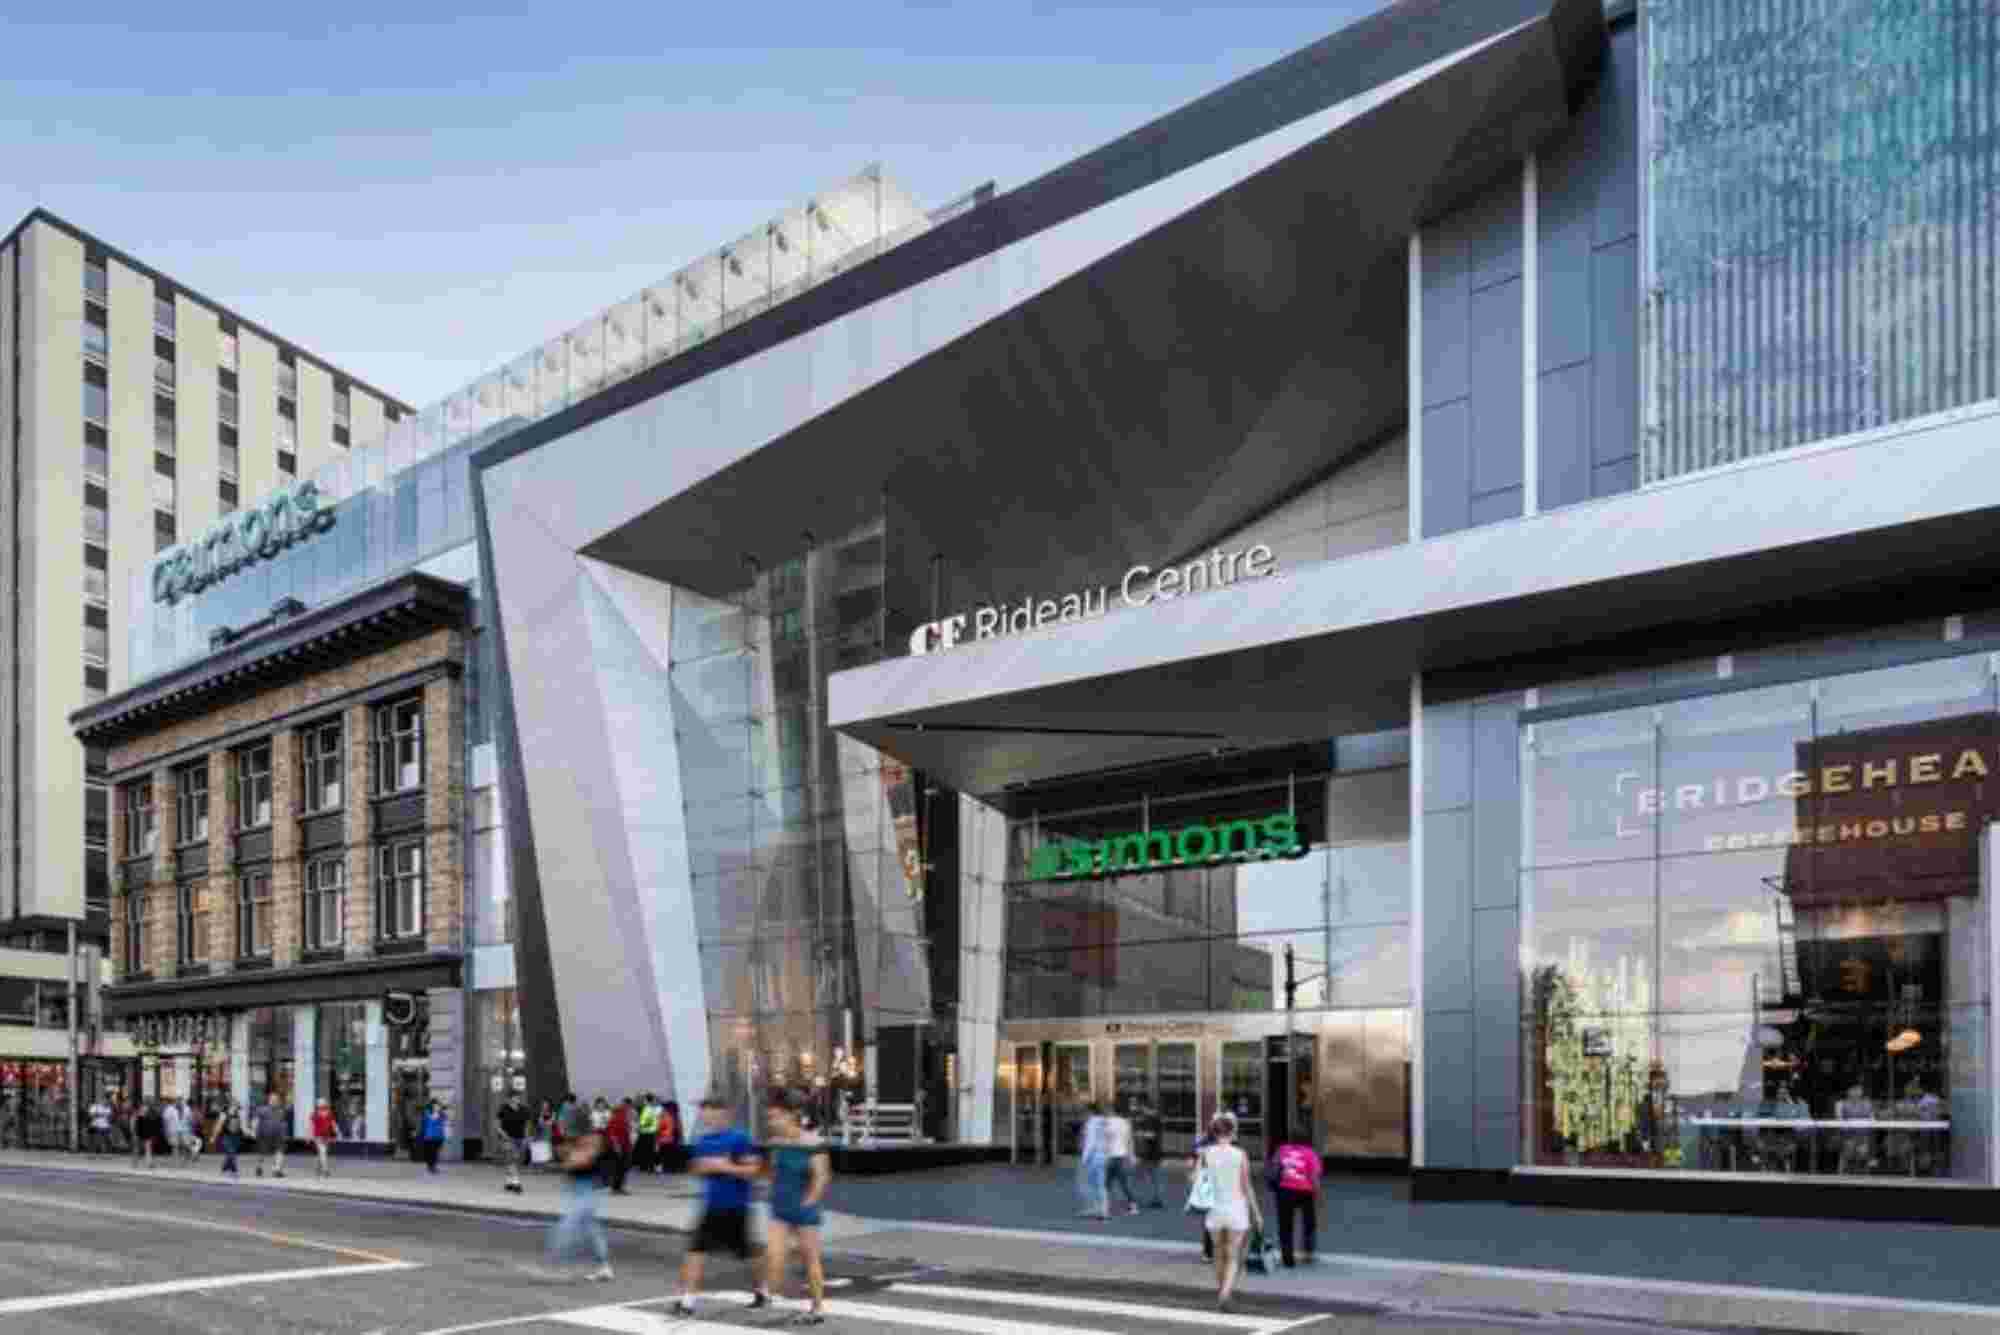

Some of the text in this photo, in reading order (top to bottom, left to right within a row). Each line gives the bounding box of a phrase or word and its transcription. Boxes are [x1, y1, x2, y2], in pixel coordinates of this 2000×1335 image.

[908, 543, 1274, 656] CF Rideau Centre
